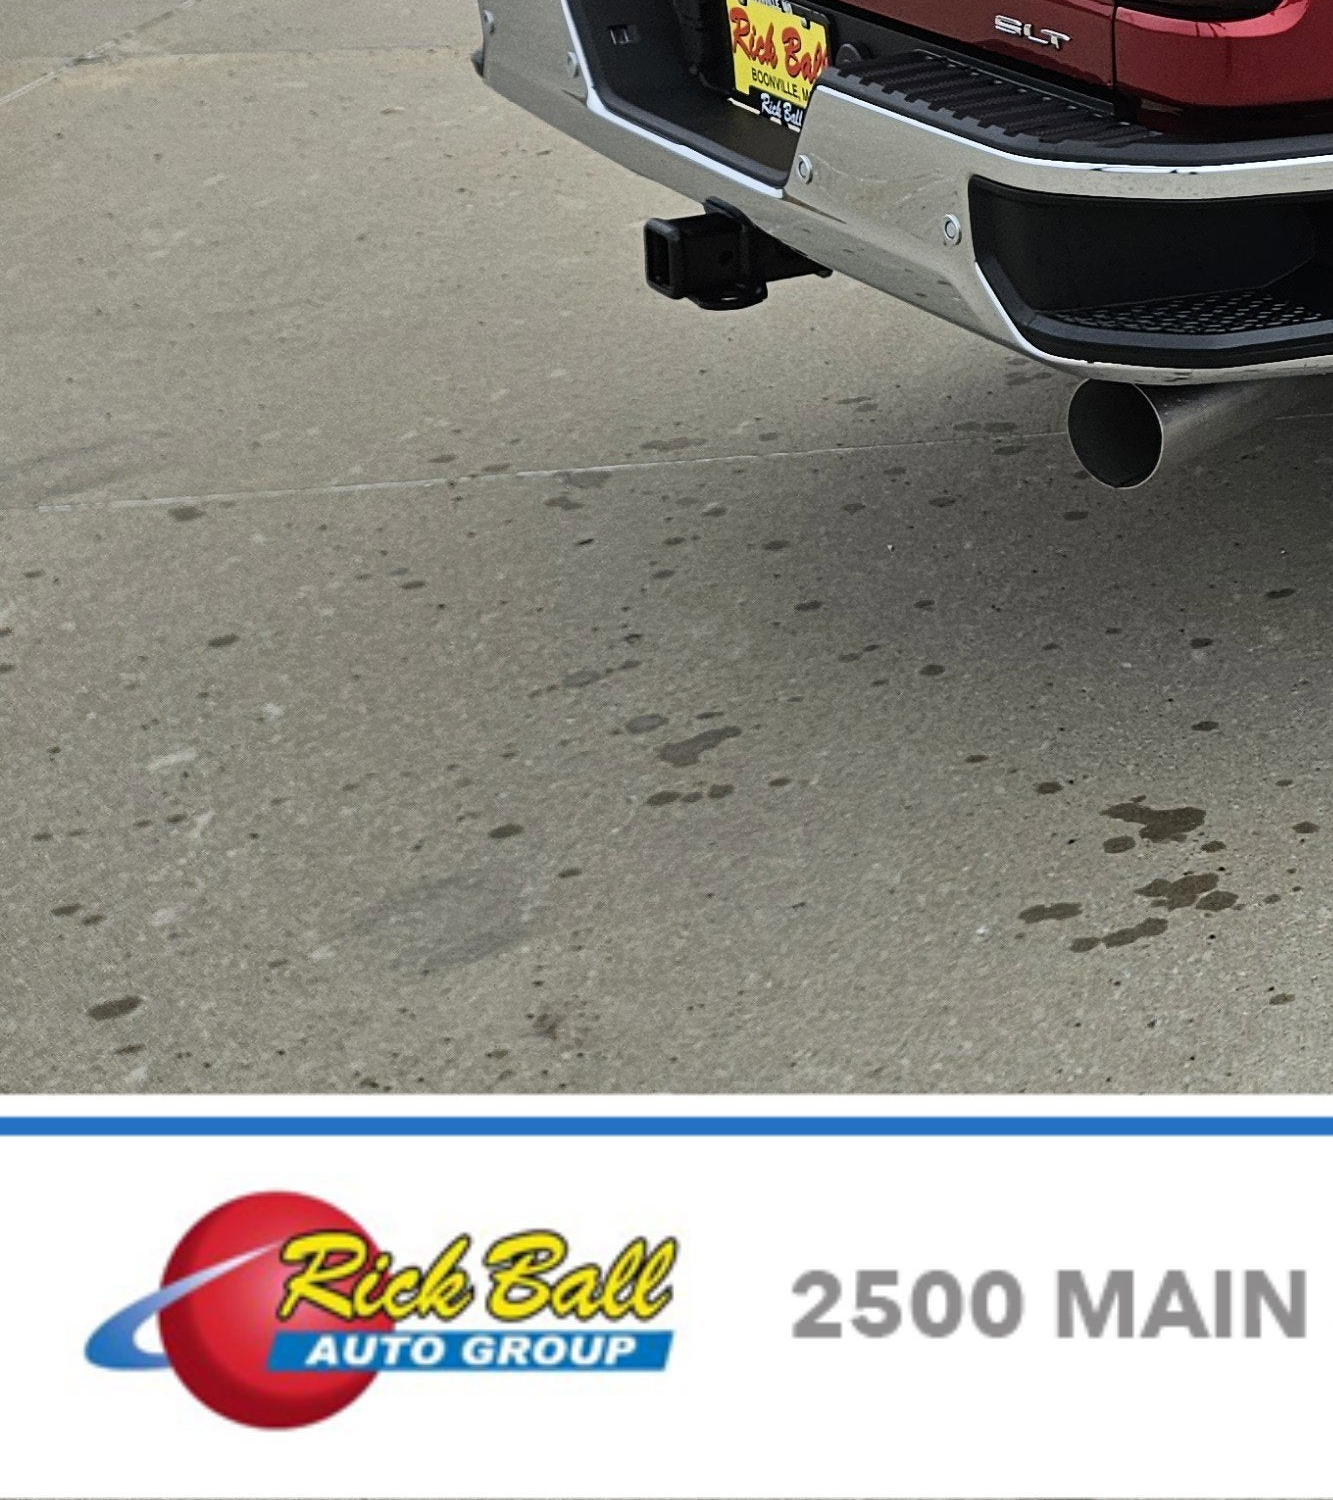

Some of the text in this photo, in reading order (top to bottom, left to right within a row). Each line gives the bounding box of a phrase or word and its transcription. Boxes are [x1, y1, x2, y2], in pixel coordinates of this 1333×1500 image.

[729, 7, 778, 69] Rick
[994, 15, 1071, 49] SLT
[760, 92, 782, 119] Rick
